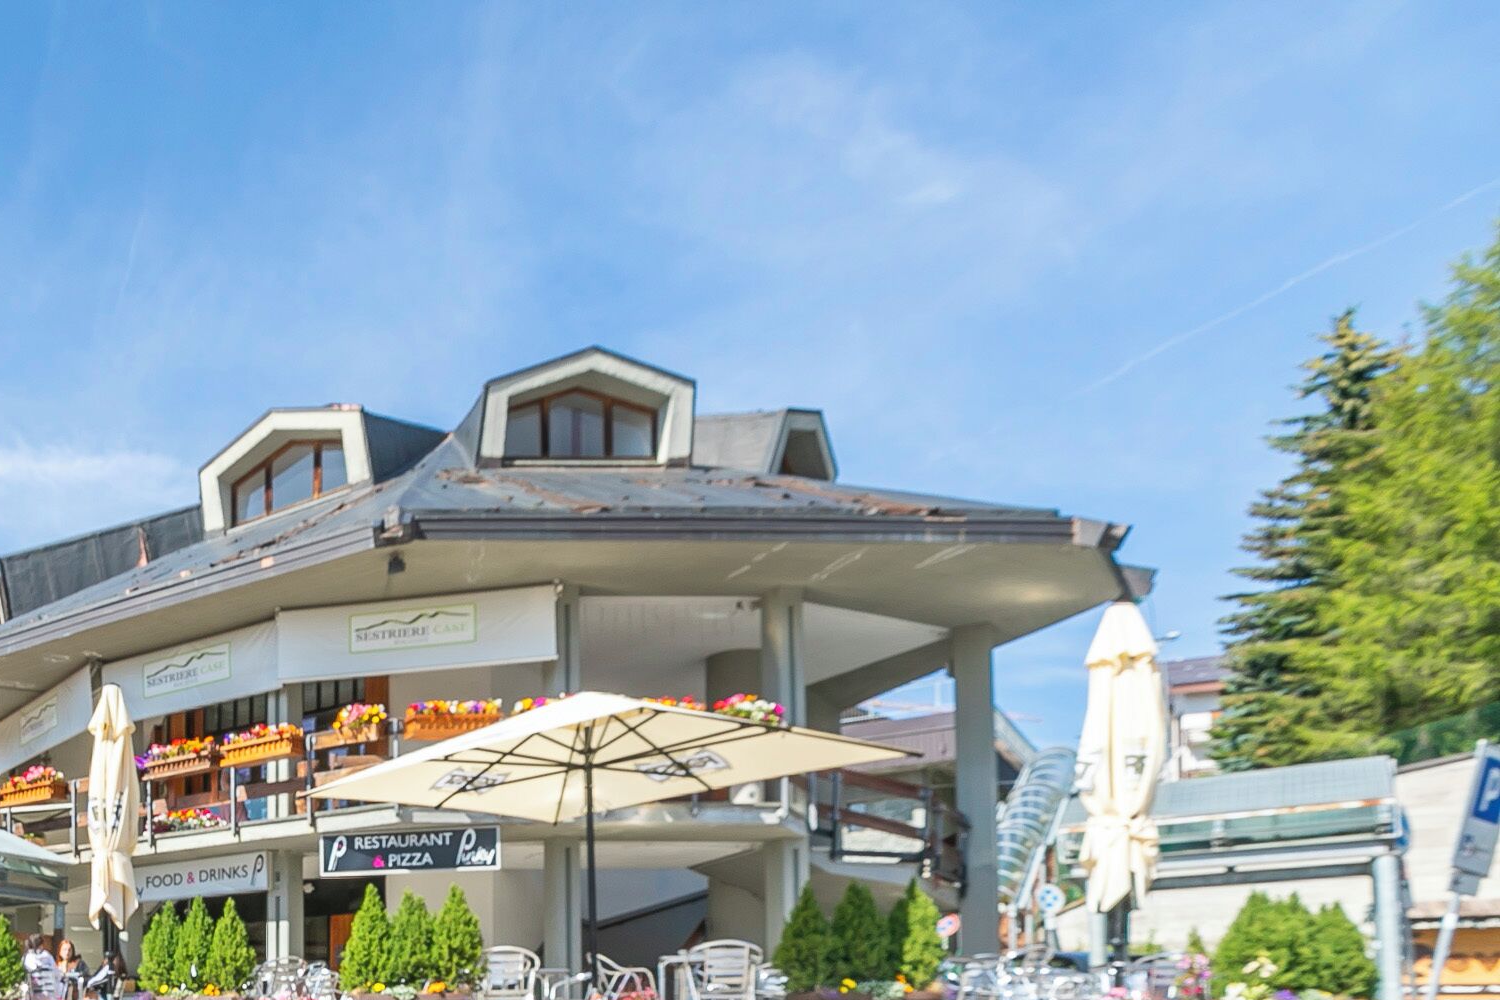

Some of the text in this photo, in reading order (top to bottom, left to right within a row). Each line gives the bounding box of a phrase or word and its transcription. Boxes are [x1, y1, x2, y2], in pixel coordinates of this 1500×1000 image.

[355, 625, 429, 641] SESTRIERE
[146, 667, 198, 688] SESTRIERE
[1478, 766, 1500, 812] P
[354, 832, 453, 850] RESTAURANT
[372, 852, 434, 868] & PIZZA
[145, 864, 249, 888] FOOD & DRINKS
